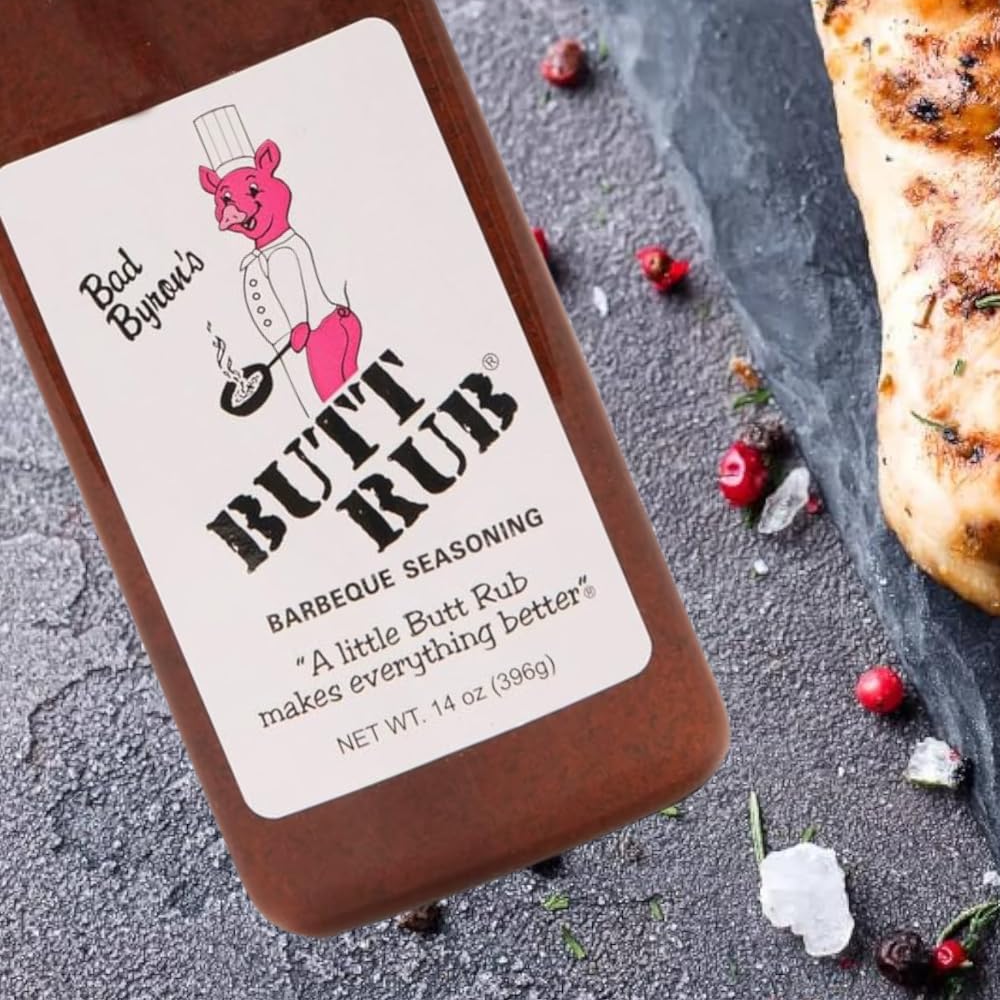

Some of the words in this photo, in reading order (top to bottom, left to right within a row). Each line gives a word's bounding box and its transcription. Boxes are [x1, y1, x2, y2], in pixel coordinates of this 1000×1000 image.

[78, 246, 144, 311] Bad
[105, 249, 205, 342] Byron's
[205, 348, 426, 574] BUTT
[335, 372, 519, 554] RUB
[266, 568, 396, 634] BARBEQUE
[402, 507, 545, 579] SEASONING
[334, 626, 401, 665] little
[402, 597, 469, 638] Butt
[470, 570, 529, 611] Rub
[257, 683, 343, 728] makes
[349, 622, 497, 694] everything
[335, 723, 380, 755] NET
[384, 706, 427, 735] WT.
[431, 694, 456, 718] 14
[461, 686, 487, 705] oz
[490, 653, 557, 698] (396g)
